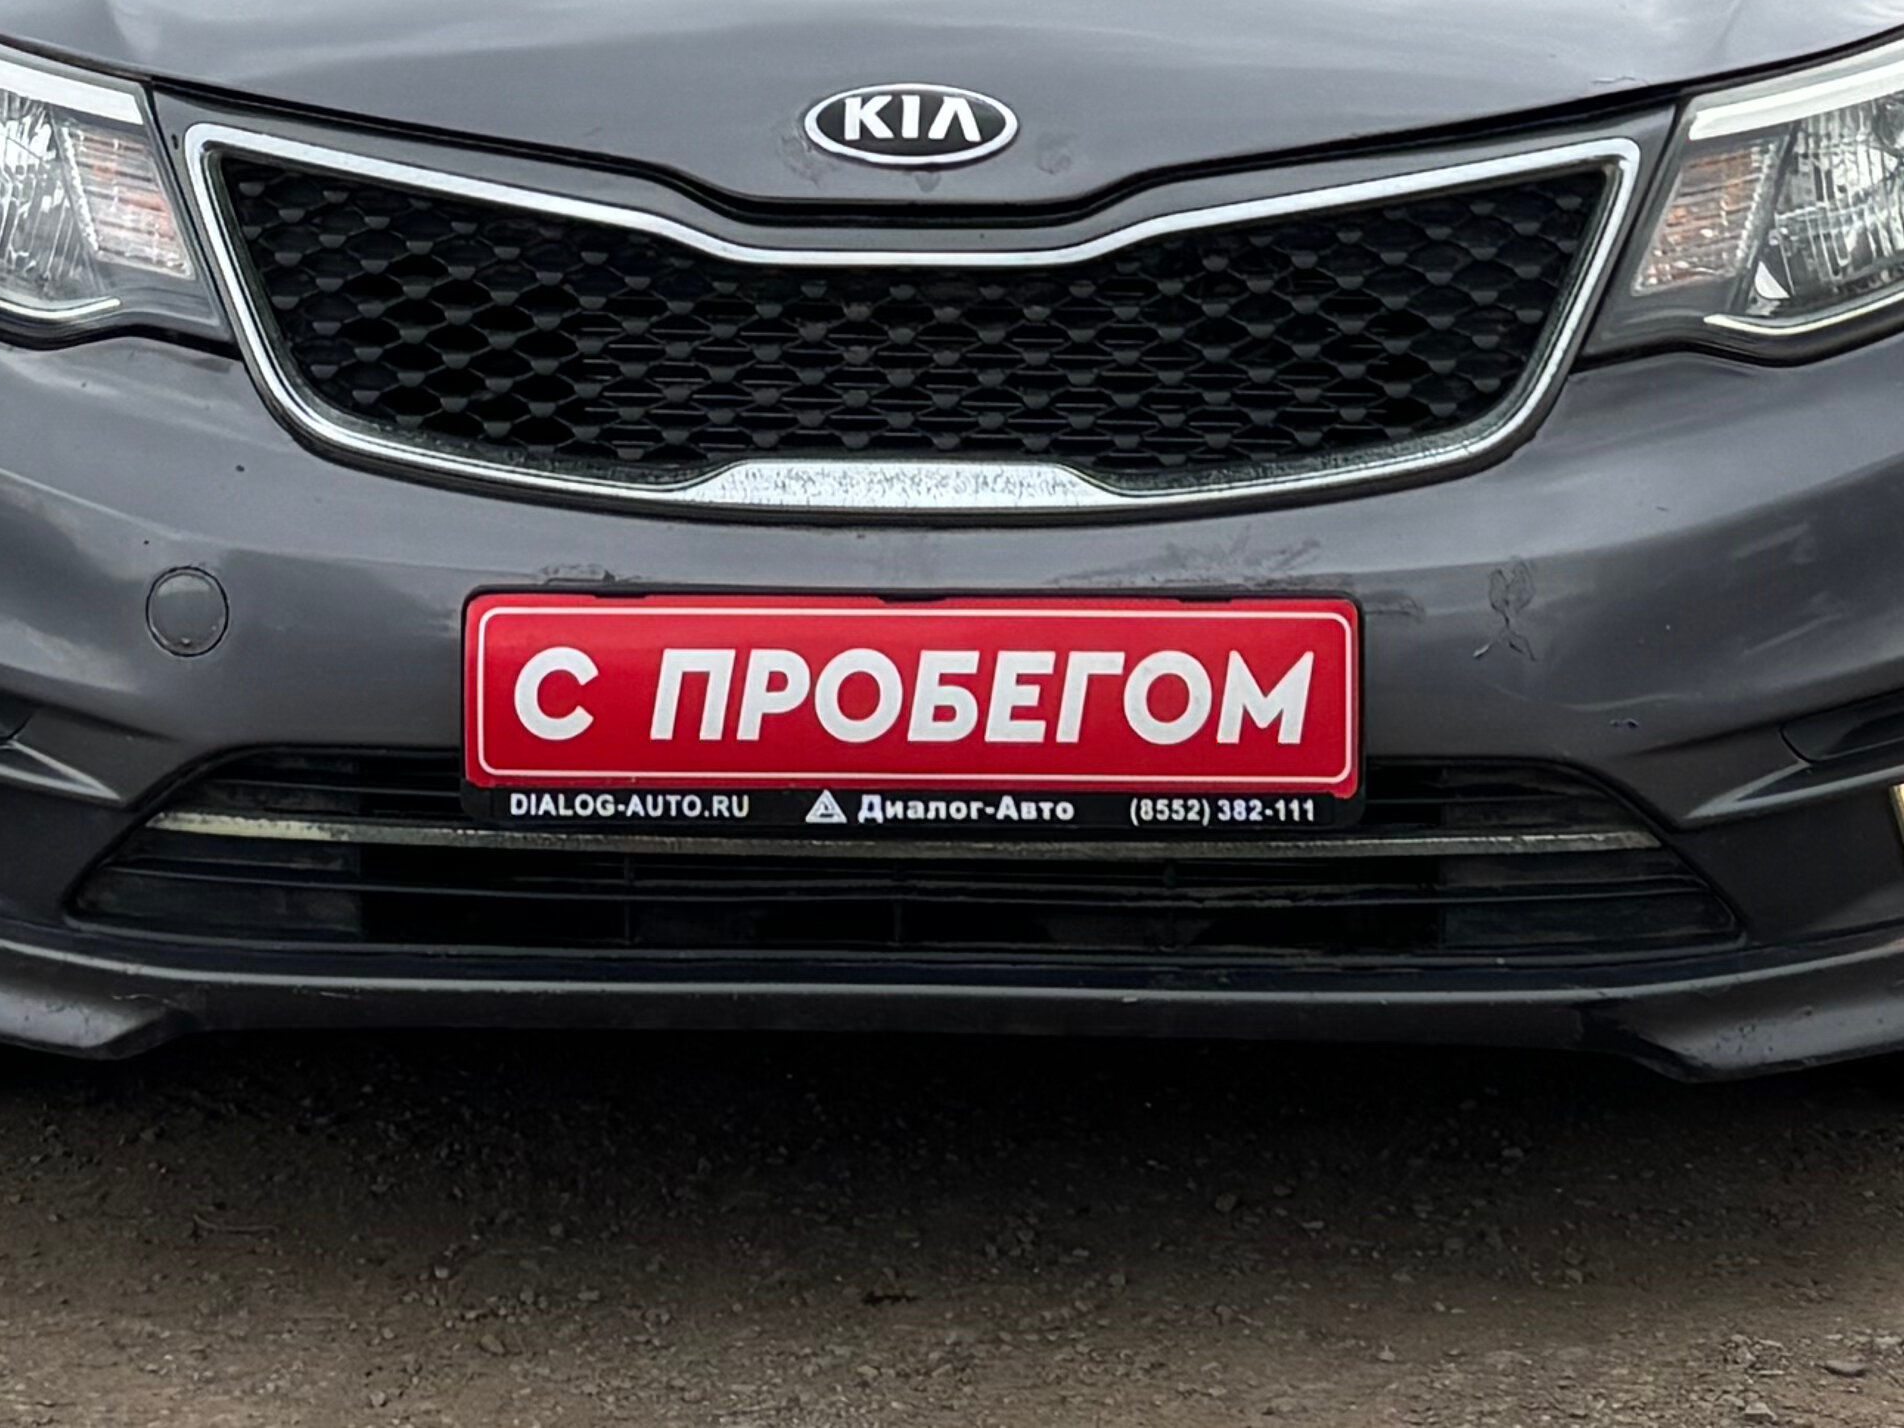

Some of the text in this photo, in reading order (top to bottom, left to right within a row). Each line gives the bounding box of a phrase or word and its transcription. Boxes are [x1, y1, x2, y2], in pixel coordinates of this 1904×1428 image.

[844, 95, 982, 142] KIA
[514, 646, 1314, 745] С ПРОБЕГОМ
[510, 793, 750, 818] DIALOG-AUTO.RU
[858, 795, 1075, 824] Диалог-Авто
[1129, 798, 1314, 826] (8552) 382-111
